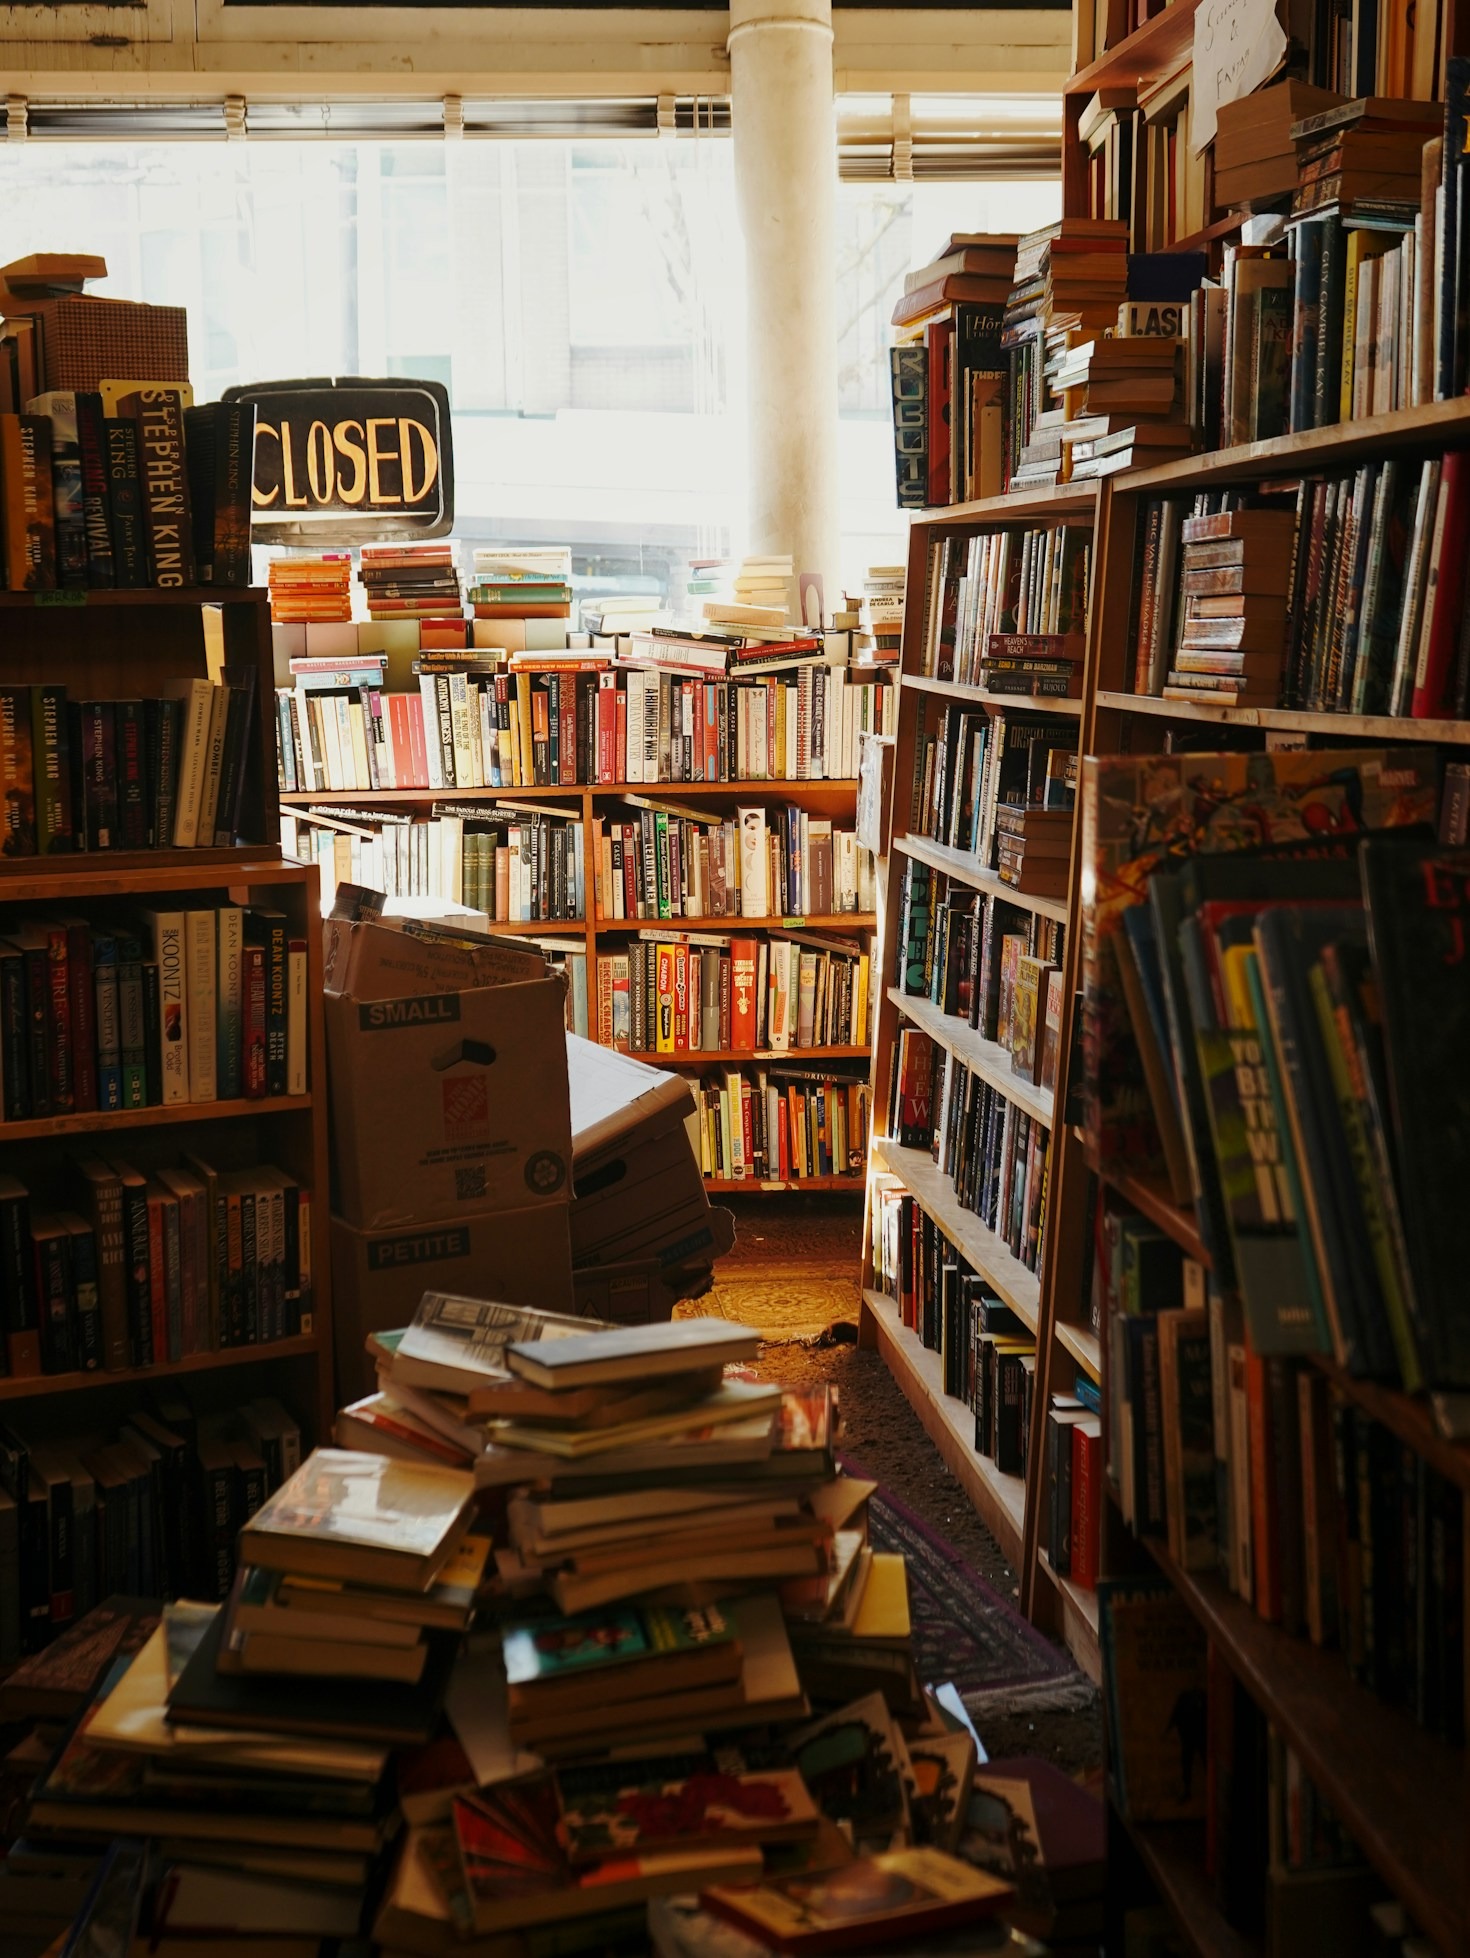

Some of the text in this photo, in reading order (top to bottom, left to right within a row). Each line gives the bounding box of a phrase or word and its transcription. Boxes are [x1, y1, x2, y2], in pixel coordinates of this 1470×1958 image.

[1347, 267, 1355, 293] GUY
[1315, 250, 1330, 399] GUY GAVRIEL KAY
[1344, 299, 1354, 352] GAVRIEL
[125, 428, 136, 478] STEPHEN
[228, 410, 240, 489] STEPHEN KING
[892, 349, 926, 508] ROBOTS
[20, 427, 37, 513] STEPHEN KING
[109, 429, 126, 479] KING
[164, 394, 185, 515] DESPERATION
[253, 418, 438, 506] CLOSED
[84, 454, 111, 561] KING REVIVAL
[140, 390, 183, 587] STEPHEN KING
[1150, 510, 1159, 540] ERIC
[1141, 574, 1153, 645] LUSTBADER
[1004, 637, 1028, 646] HEAVEN'S
[1007, 646, 1024, 654] REACH
[423, 664, 450, 672] The Gallery
[560, 674, 568, 709] BURGESS
[1042, 684, 1066, 692] BUJOLD
[437, 678, 452, 744] ANTHONY BURGESS
[645, 695, 658, 727] RUMOR
[815, 673, 823, 720] PETER CAREY
[1, 697, 17, 780] STEPHEN KING
[43, 697, 59, 779] STEPHEN KING
[93, 720, 104, 782] STEPHEN KING
[124, 722, 138, 780] STEPHEN KING
[630, 694, 641, 761] INDIAN COUNTRY
[645, 728, 658, 739] OF
[645, 740, 657, 761] WAR
[159, 719, 171, 844] STEPHEN KING REVIVAL
[211, 738, 221, 776] ZOMBIE
[645, 844, 656, 904] LEADING MEN
[162, 934, 180, 1000] KOONTZ
[229, 915, 237, 1006] DEAN KOONTZ
[272, 929, 283, 1014] DEAN KOONTZ
[603, 962, 611, 1003] MICHAEL
[660, 958, 668, 991] CHABON
[51, 967, 67, 1010] FIRE
[250, 981, 264, 1001] DEAN
[102, 988, 113, 1046] VENDETTA
[127, 986, 140, 1044] POSSESSION
[369, 1003, 452, 1026] SMALL
[56, 1034, 66, 1092] HUMPHREYS
[166, 1053, 175, 1070] Odd
[174, 1045, 182, 1076] Brother
[804, 1072, 838, 1083] DRIVEN
[445, 1075, 487, 1123] HOME
[730, 1078, 738, 1113] SOUTHERN
[732, 1114, 740, 1137] CROSS
[244, 1207, 255, 1263] DARREN SHAN
[258, 1203, 268, 1237] DARREN
[272, 1202, 283, 1258] DARREN SHAN
[379, 1234, 462, 1265] PETITE
[215, 1481, 226, 1526] DEL TORO
[1077, 1439, 1088, 1574] neal stephenson
[216, 1550, 230, 1595] HOGAN
